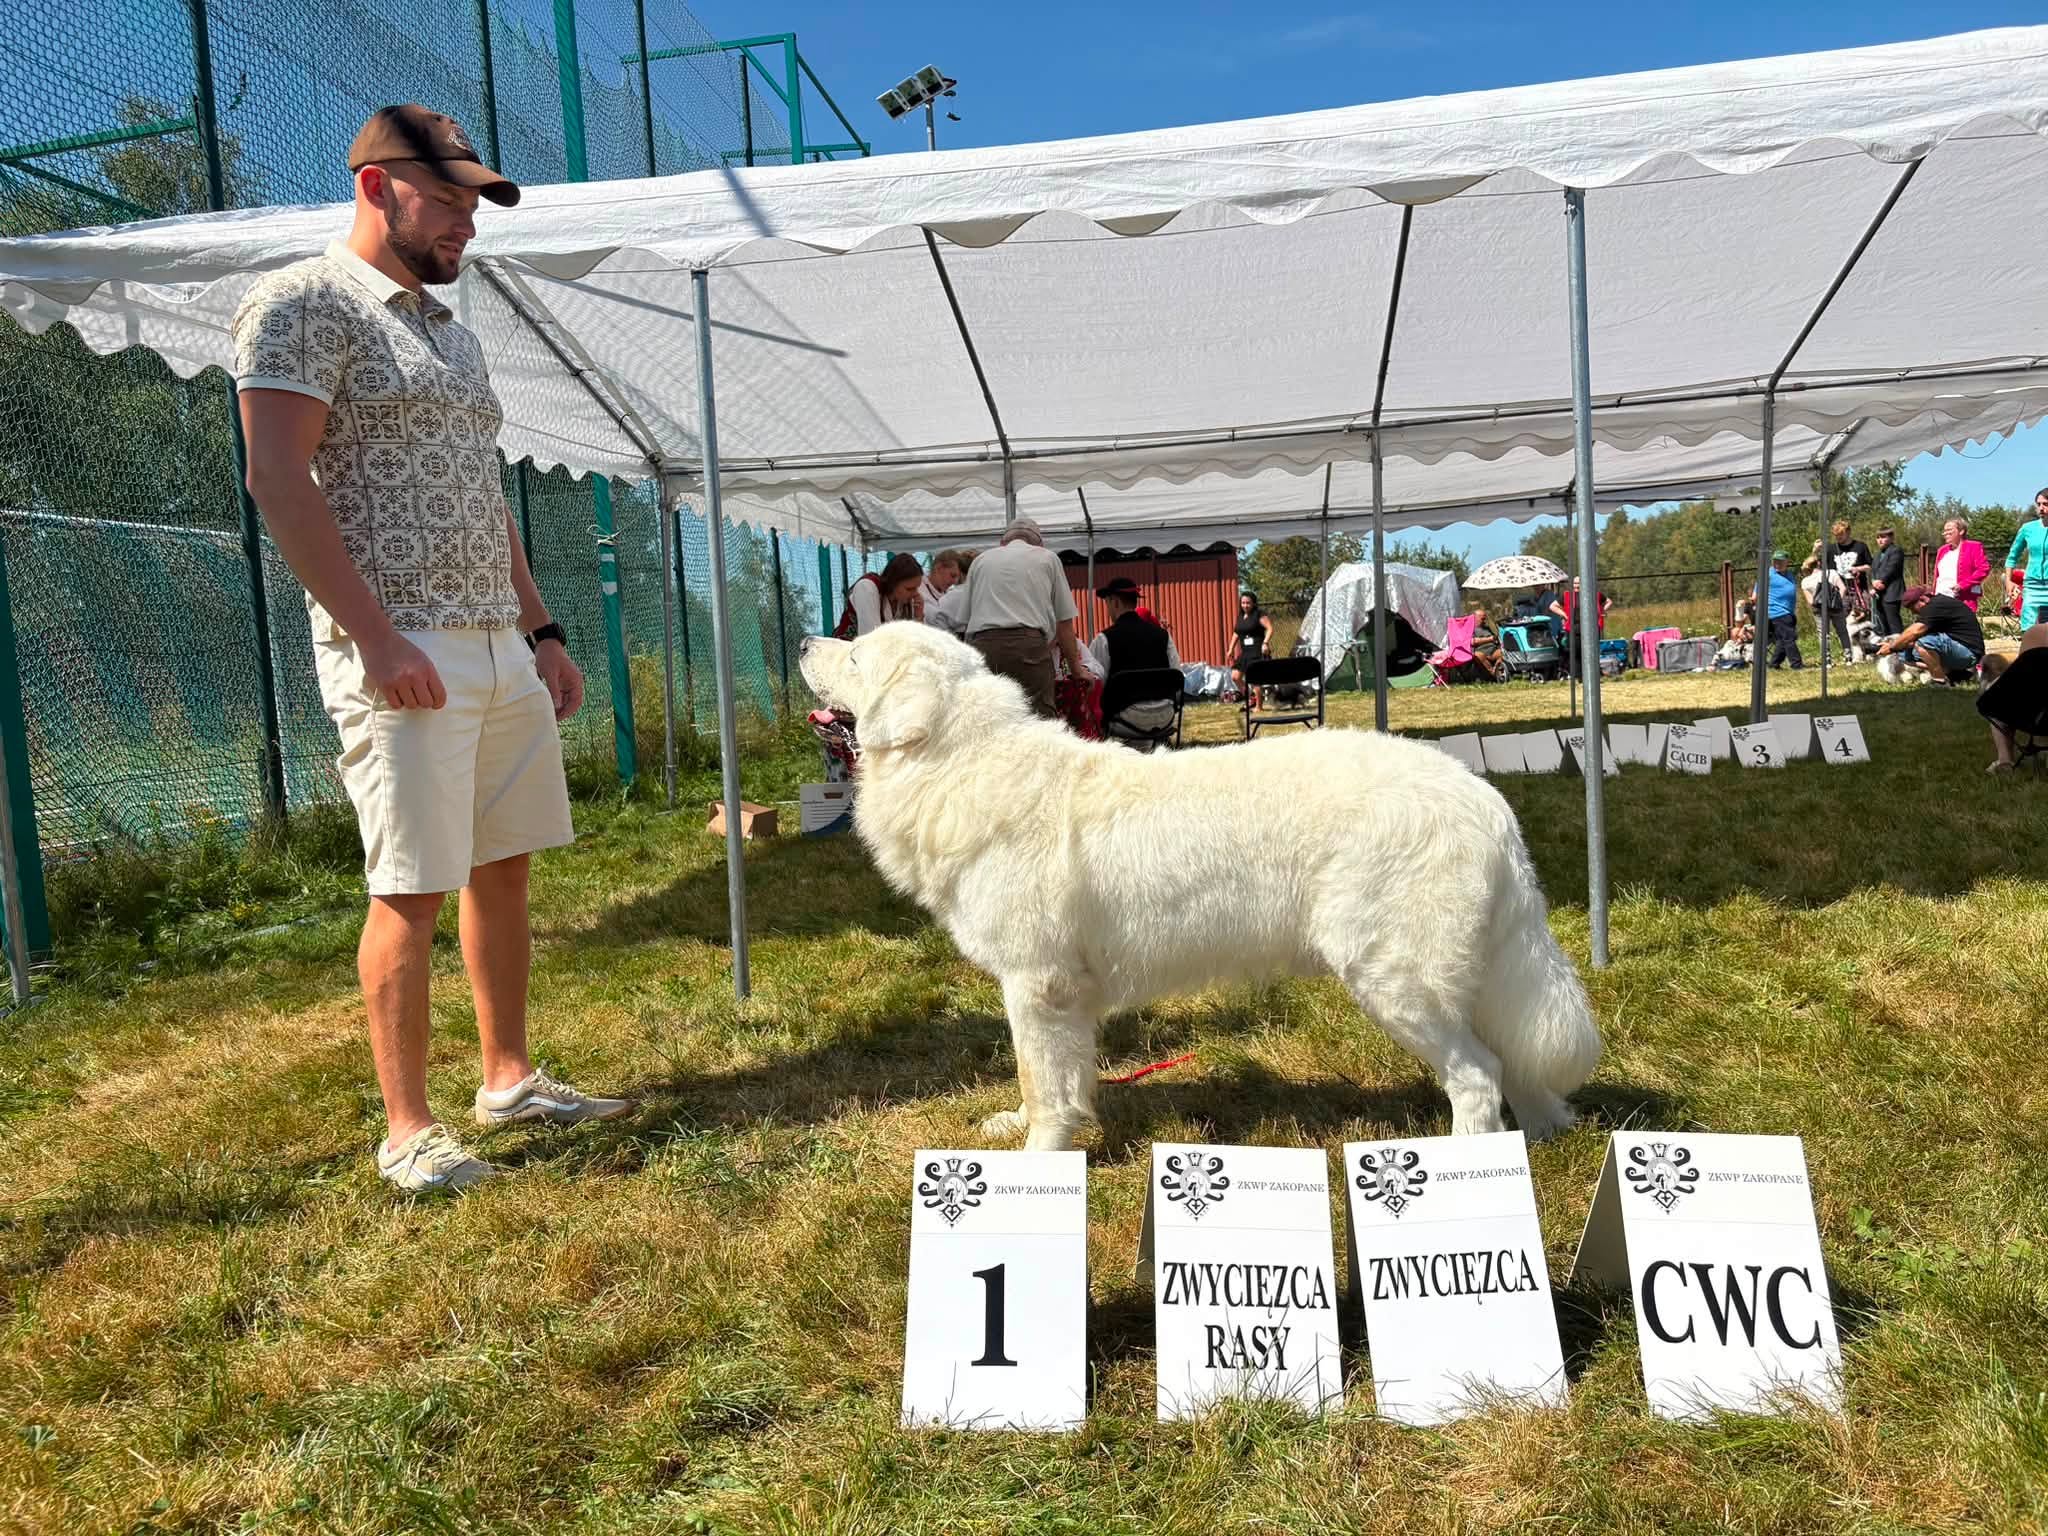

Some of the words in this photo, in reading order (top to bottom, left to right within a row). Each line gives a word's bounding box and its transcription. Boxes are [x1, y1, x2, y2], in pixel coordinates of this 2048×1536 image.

[1752, 744, 1771, 765] 3
[1834, 737, 1854, 757] 4
[1670, 750, 1707, 765] CACIB
[1436, 1171, 1467, 1182] ZKWP
[1469, 1167, 1527, 1179] ZAKOPANE
[1708, 1172, 1740, 1183] ZKWP
[1742, 1174, 1803, 1185] ZAKOPANE
[994, 1186, 1024, 1195] ZKWP
[1026, 1186, 1082, 1195] ZAKOPANE
[1237, 1182, 1268, 1192] ZKWP
[1269, 1183, 1325, 1193] ZAKOPANE
[1369, 1248, 1540, 1305] ZWYCIĘZCA
[1162, 1262, 1331, 1319] ZWYCIĘZCA
[1641, 1259, 1823, 1349] CWC
[971, 1263, 1018, 1367] 1
[1204, 1324, 1291, 1371] RASY
